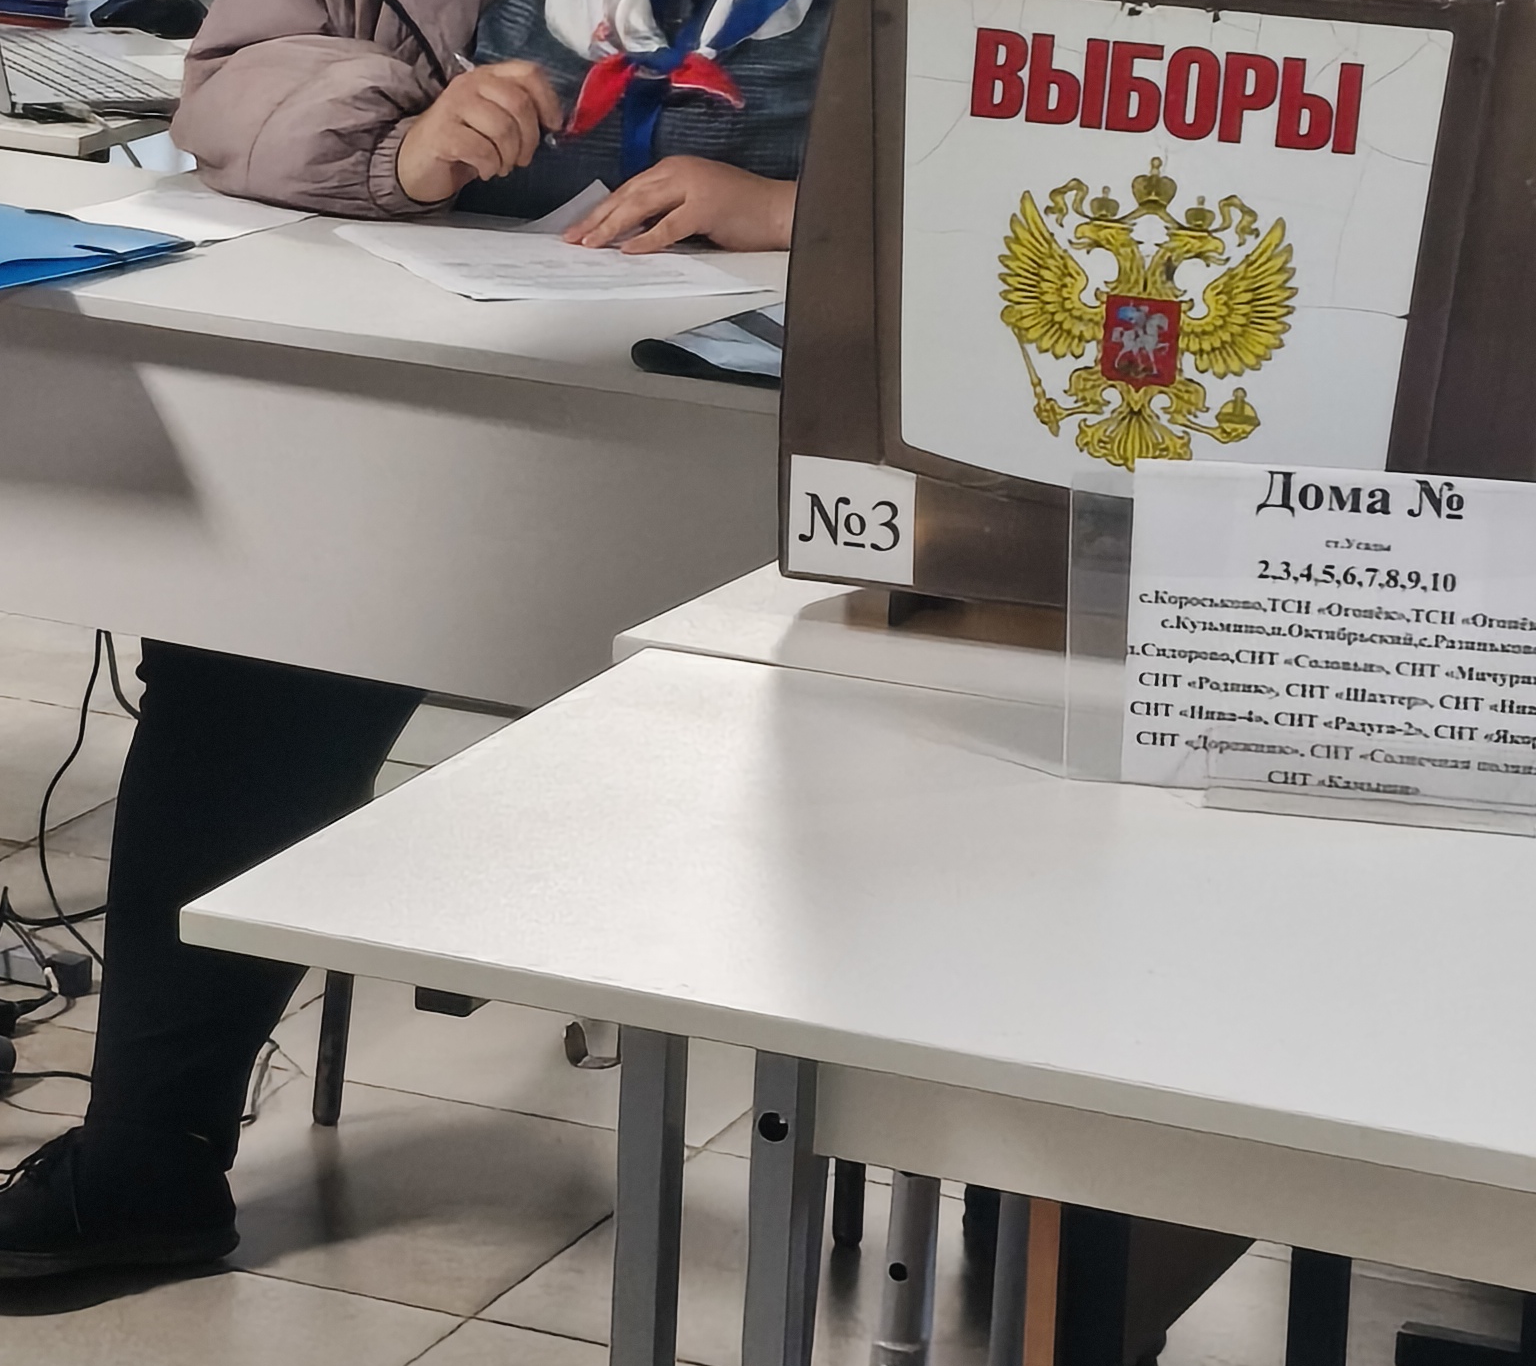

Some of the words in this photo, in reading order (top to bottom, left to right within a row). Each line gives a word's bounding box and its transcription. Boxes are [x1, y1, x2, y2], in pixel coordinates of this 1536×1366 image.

[970, 27, 1365, 155] ВЫБОРЫ
[1255, 470, 1392, 518] Дома
[1407, 479, 1465, 521] №
[798, 491, 901, 552] №3
[1395, 661, 1441, 679] СНТ
[1137, 671, 1183, 689] СНТ
[1285, 682, 1331, 700] СНТ
[1438, 694, 1485, 712] СНТ
[1129, 700, 1174, 718] СНТ
[1273, 711, 1319, 729] СНТ
[1433, 724, 1479, 742] СНТ
[1135, 730, 1180, 747] СНТ
[1310, 743, 1354, 762] СНТ
[1267, 769, 1313, 787] СНТ
